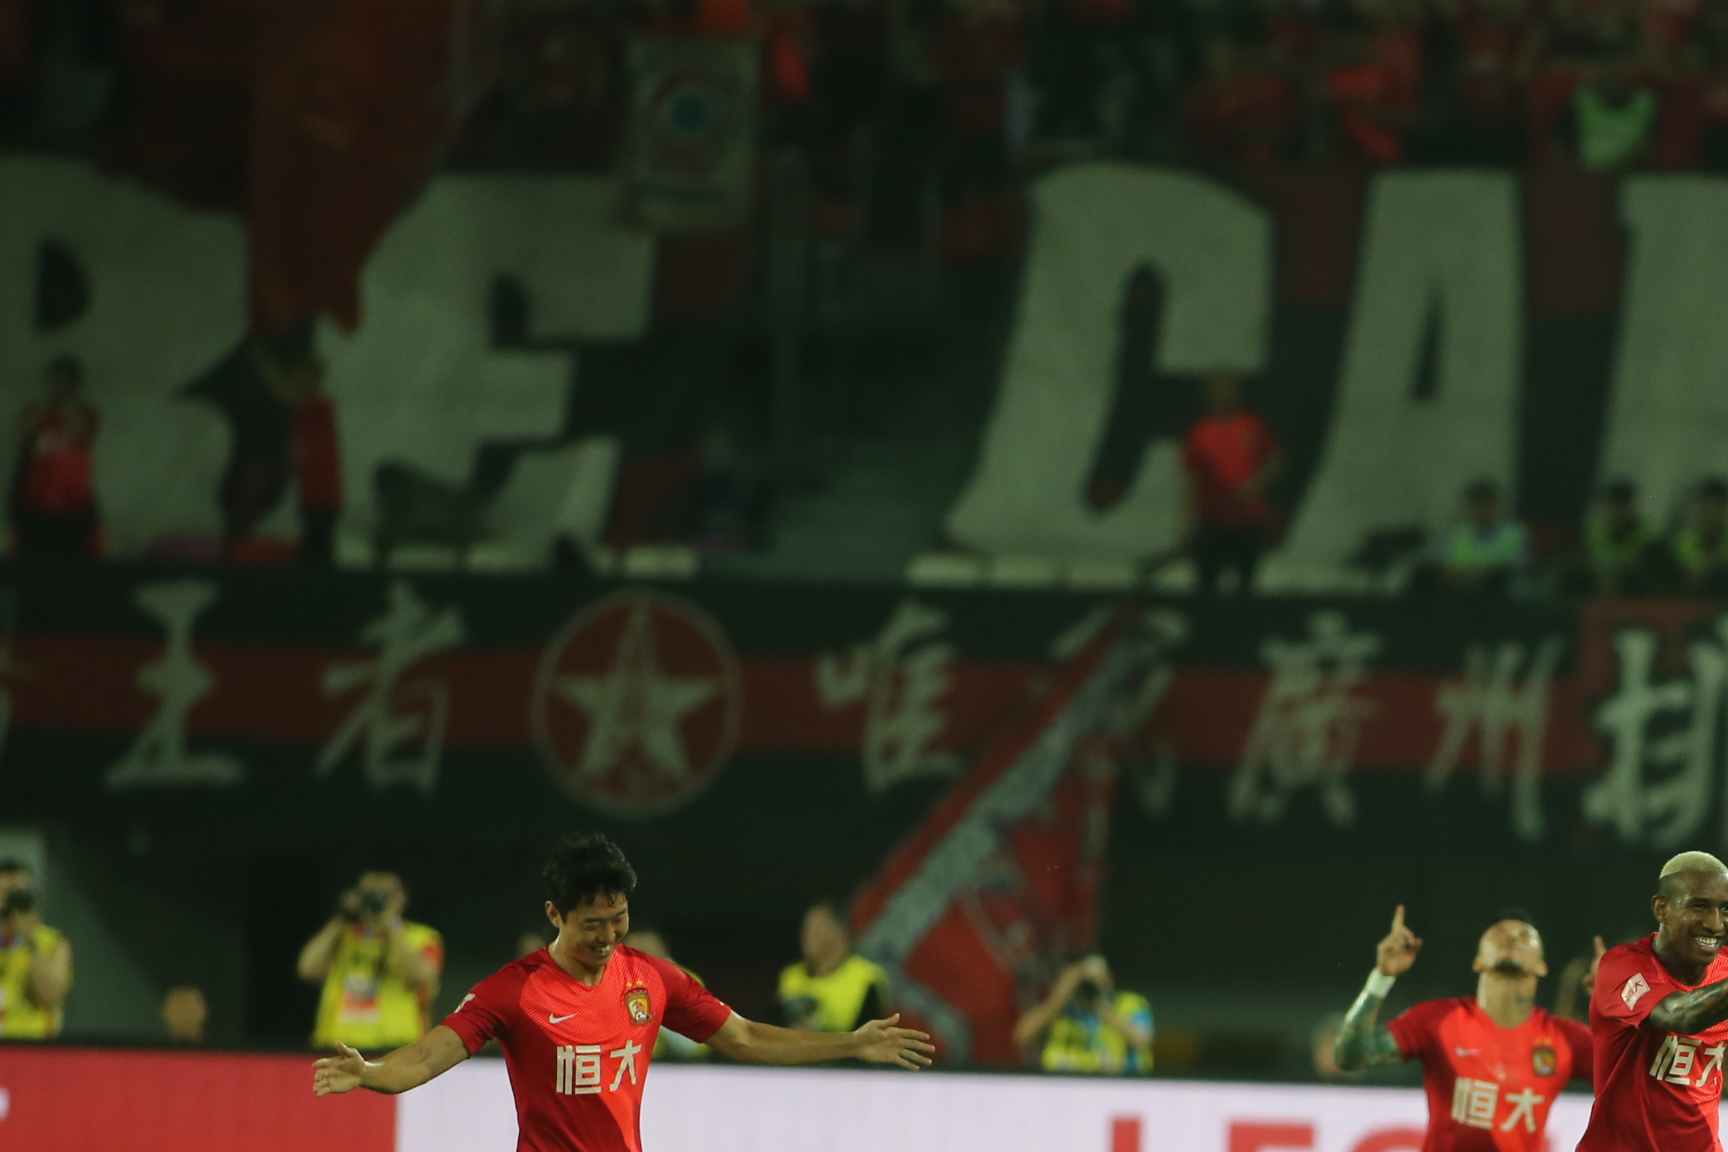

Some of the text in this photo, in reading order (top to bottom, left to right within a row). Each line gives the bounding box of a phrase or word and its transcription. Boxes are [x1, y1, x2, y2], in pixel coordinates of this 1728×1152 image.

[0, 578, 470, 796] 王者
[556, 1039, 643, 1096] 恒大
[1648, 1034, 1727, 1088] 恒大
[1450, 1076, 1546, 1134] 恒大
